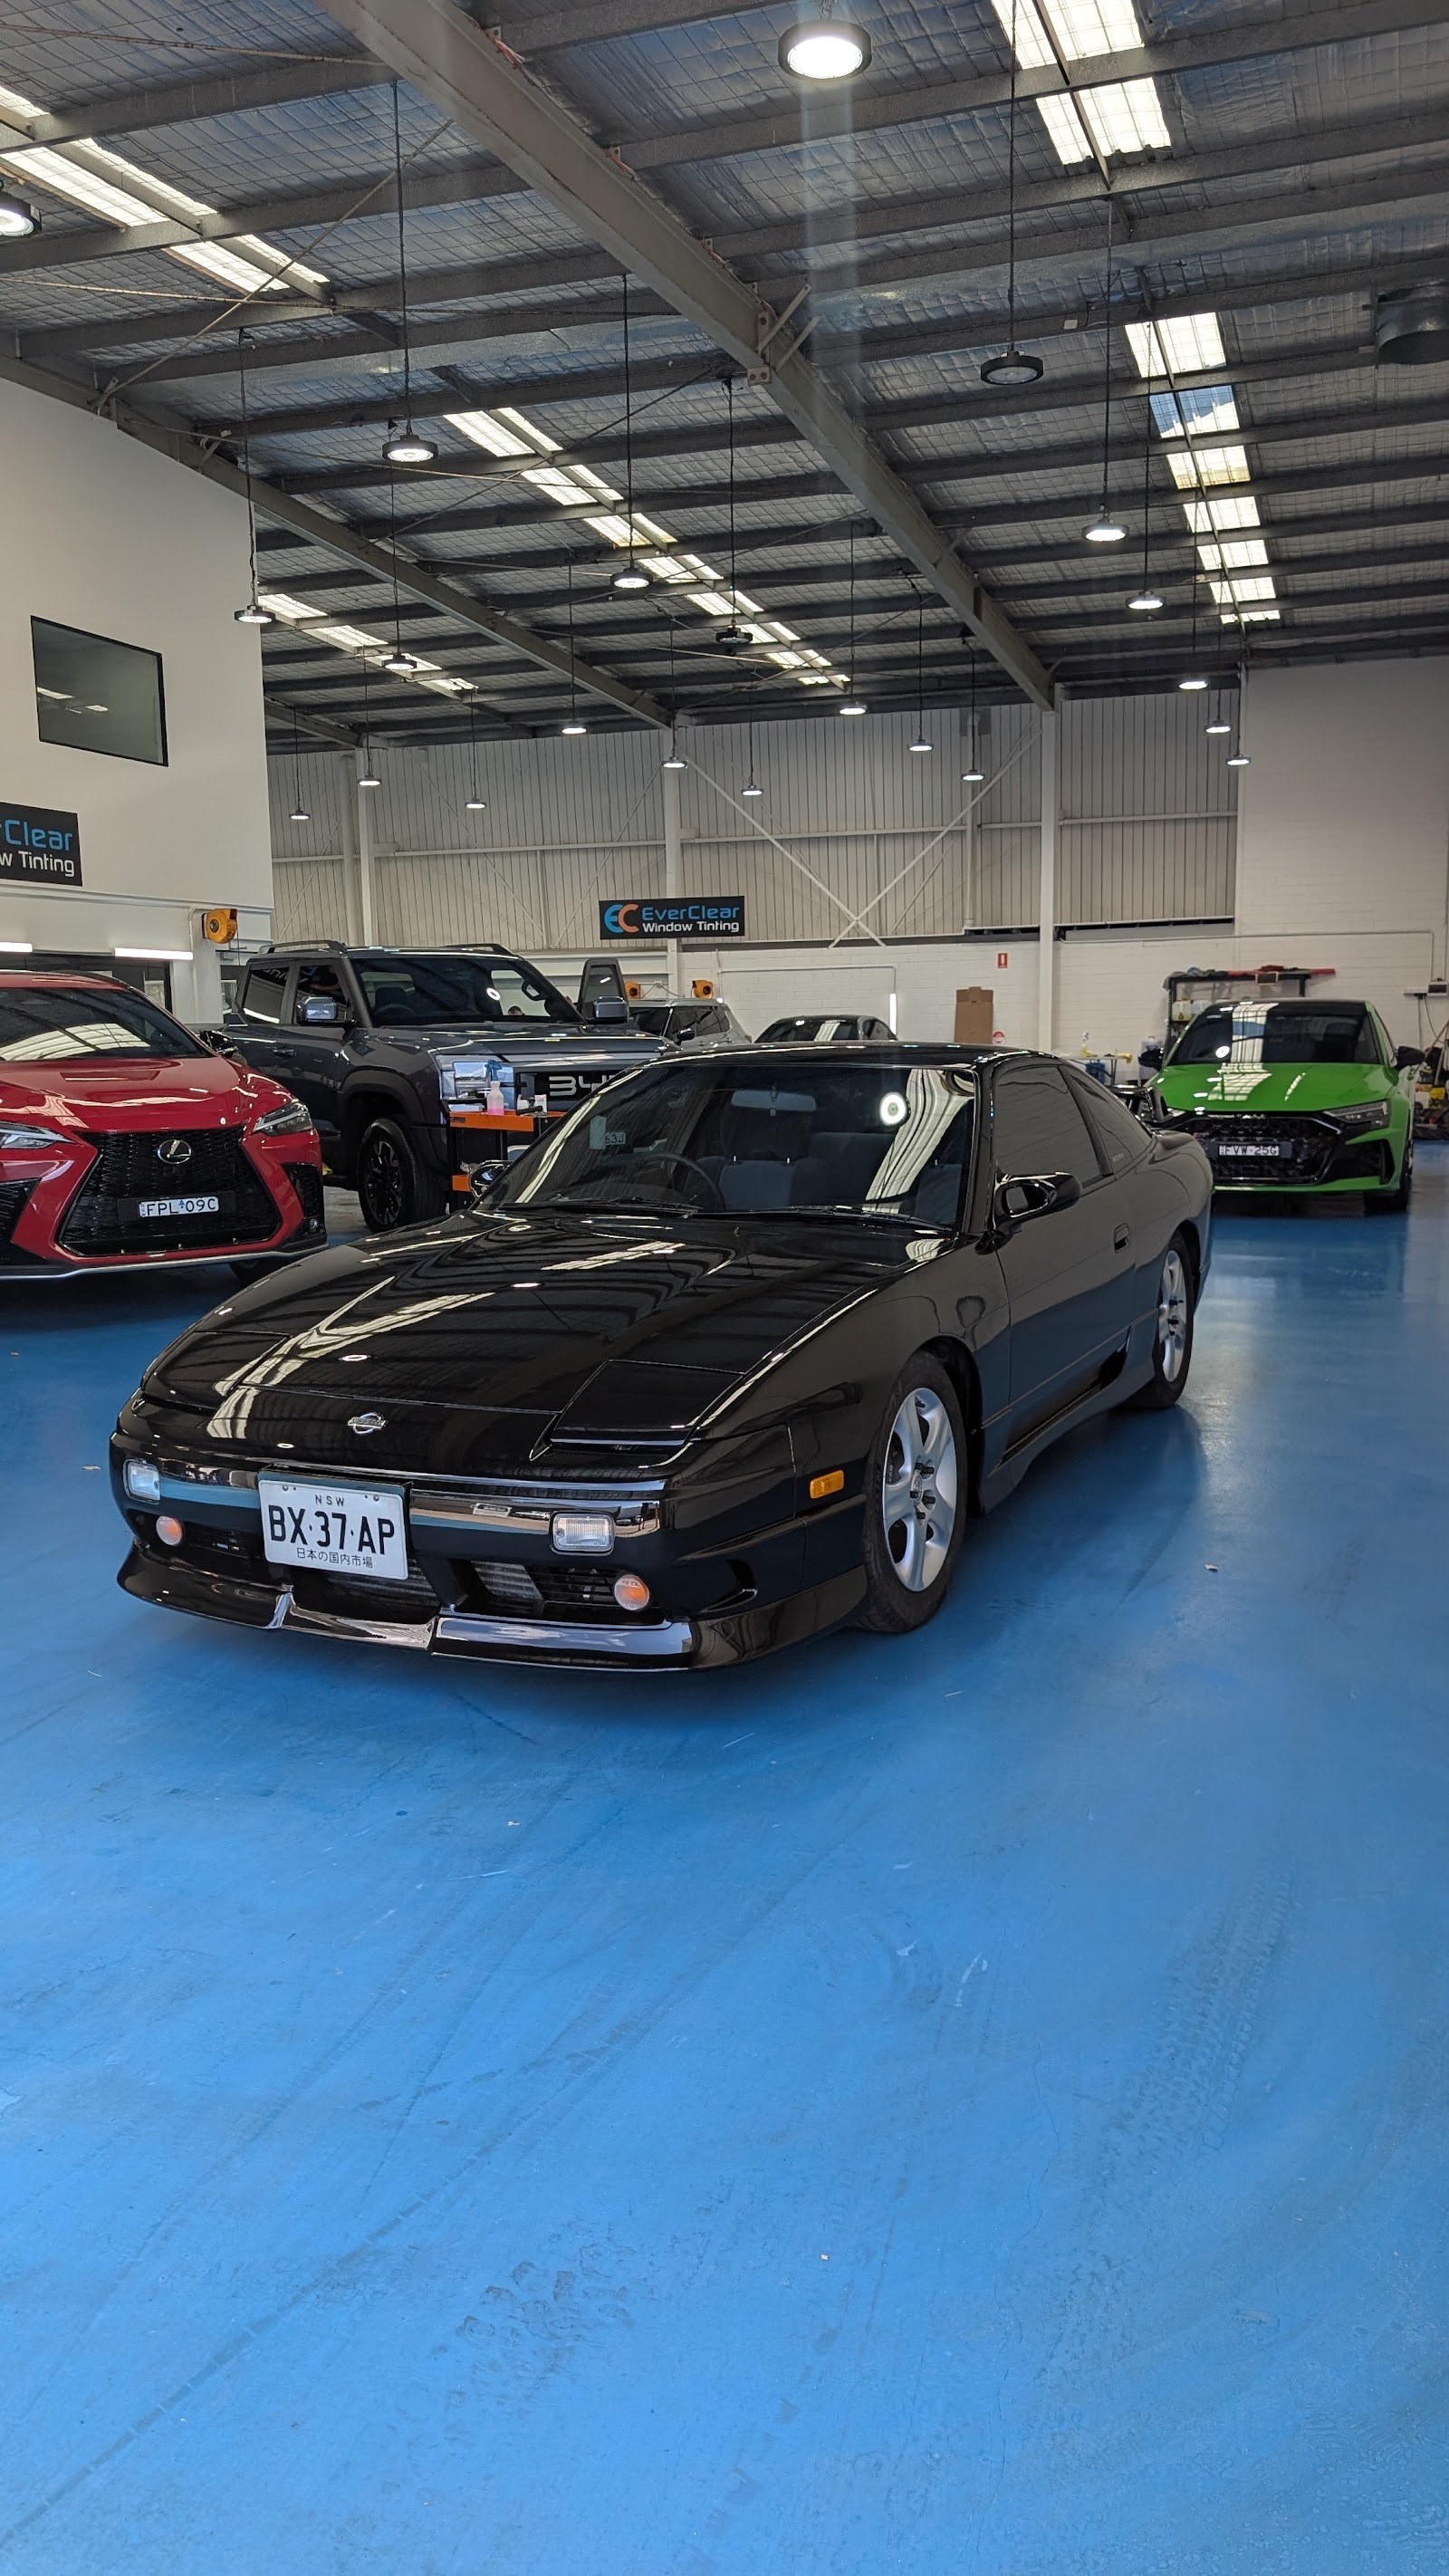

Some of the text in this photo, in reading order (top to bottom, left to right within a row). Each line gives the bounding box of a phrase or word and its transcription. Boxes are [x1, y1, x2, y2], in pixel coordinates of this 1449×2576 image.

[0, 819, 73, 851] Clear
[18, 851, 75, 877] Tinting
[641, 906, 740, 921] EverClear
[642, 920, 740, 933] Window Tinting
[315, 1495, 345, 1507] NSW
[296, 1547, 373, 1569] 日本の国内市場
